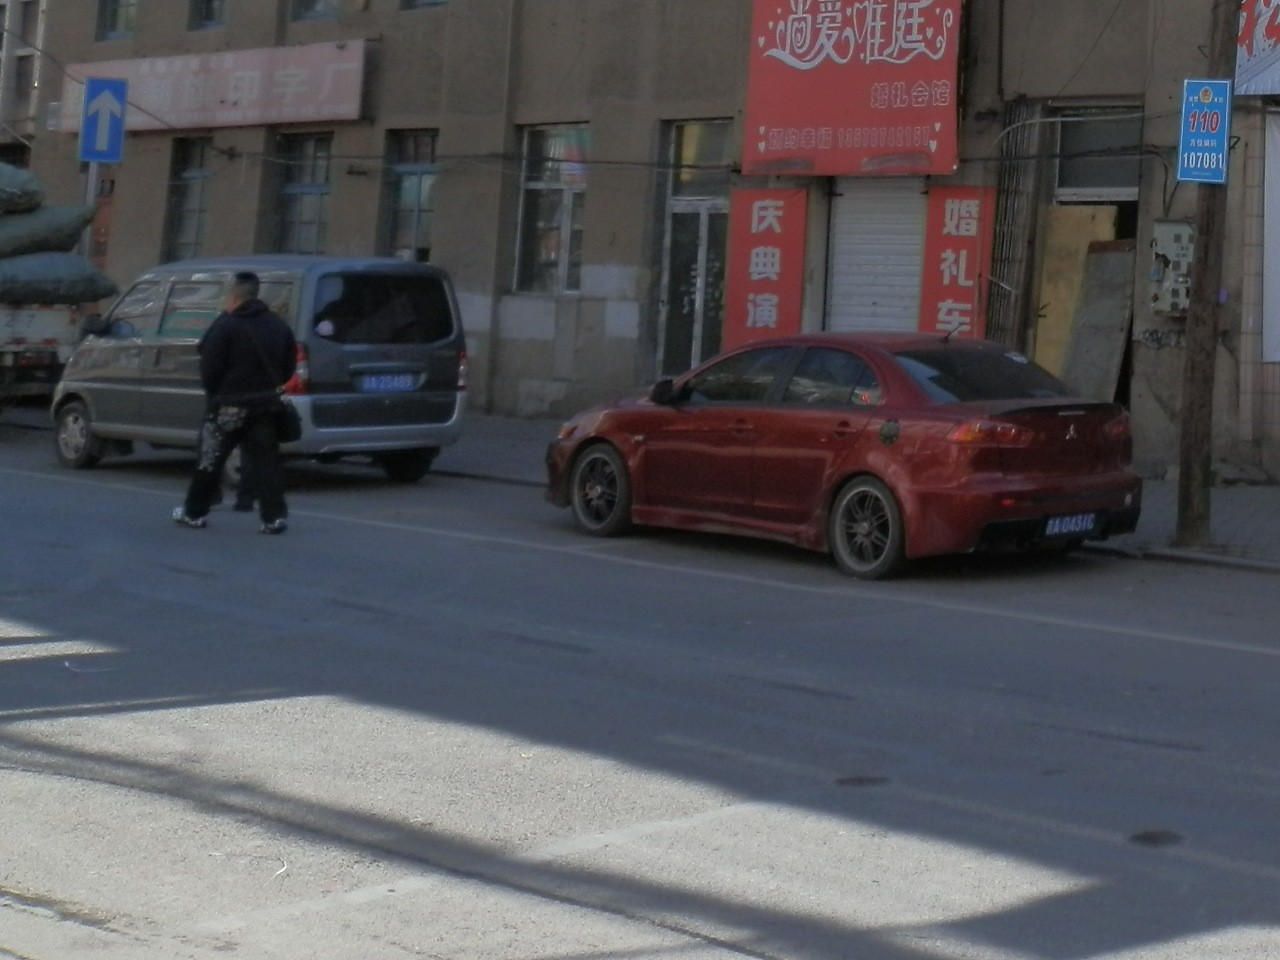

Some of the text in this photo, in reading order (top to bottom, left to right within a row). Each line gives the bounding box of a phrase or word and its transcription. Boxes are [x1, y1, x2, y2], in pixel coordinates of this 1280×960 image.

[870, 80, 950, 109] 婚礼会馆
[1188, 110, 1221, 133] 110
[1183, 152, 1224, 169] 107081
